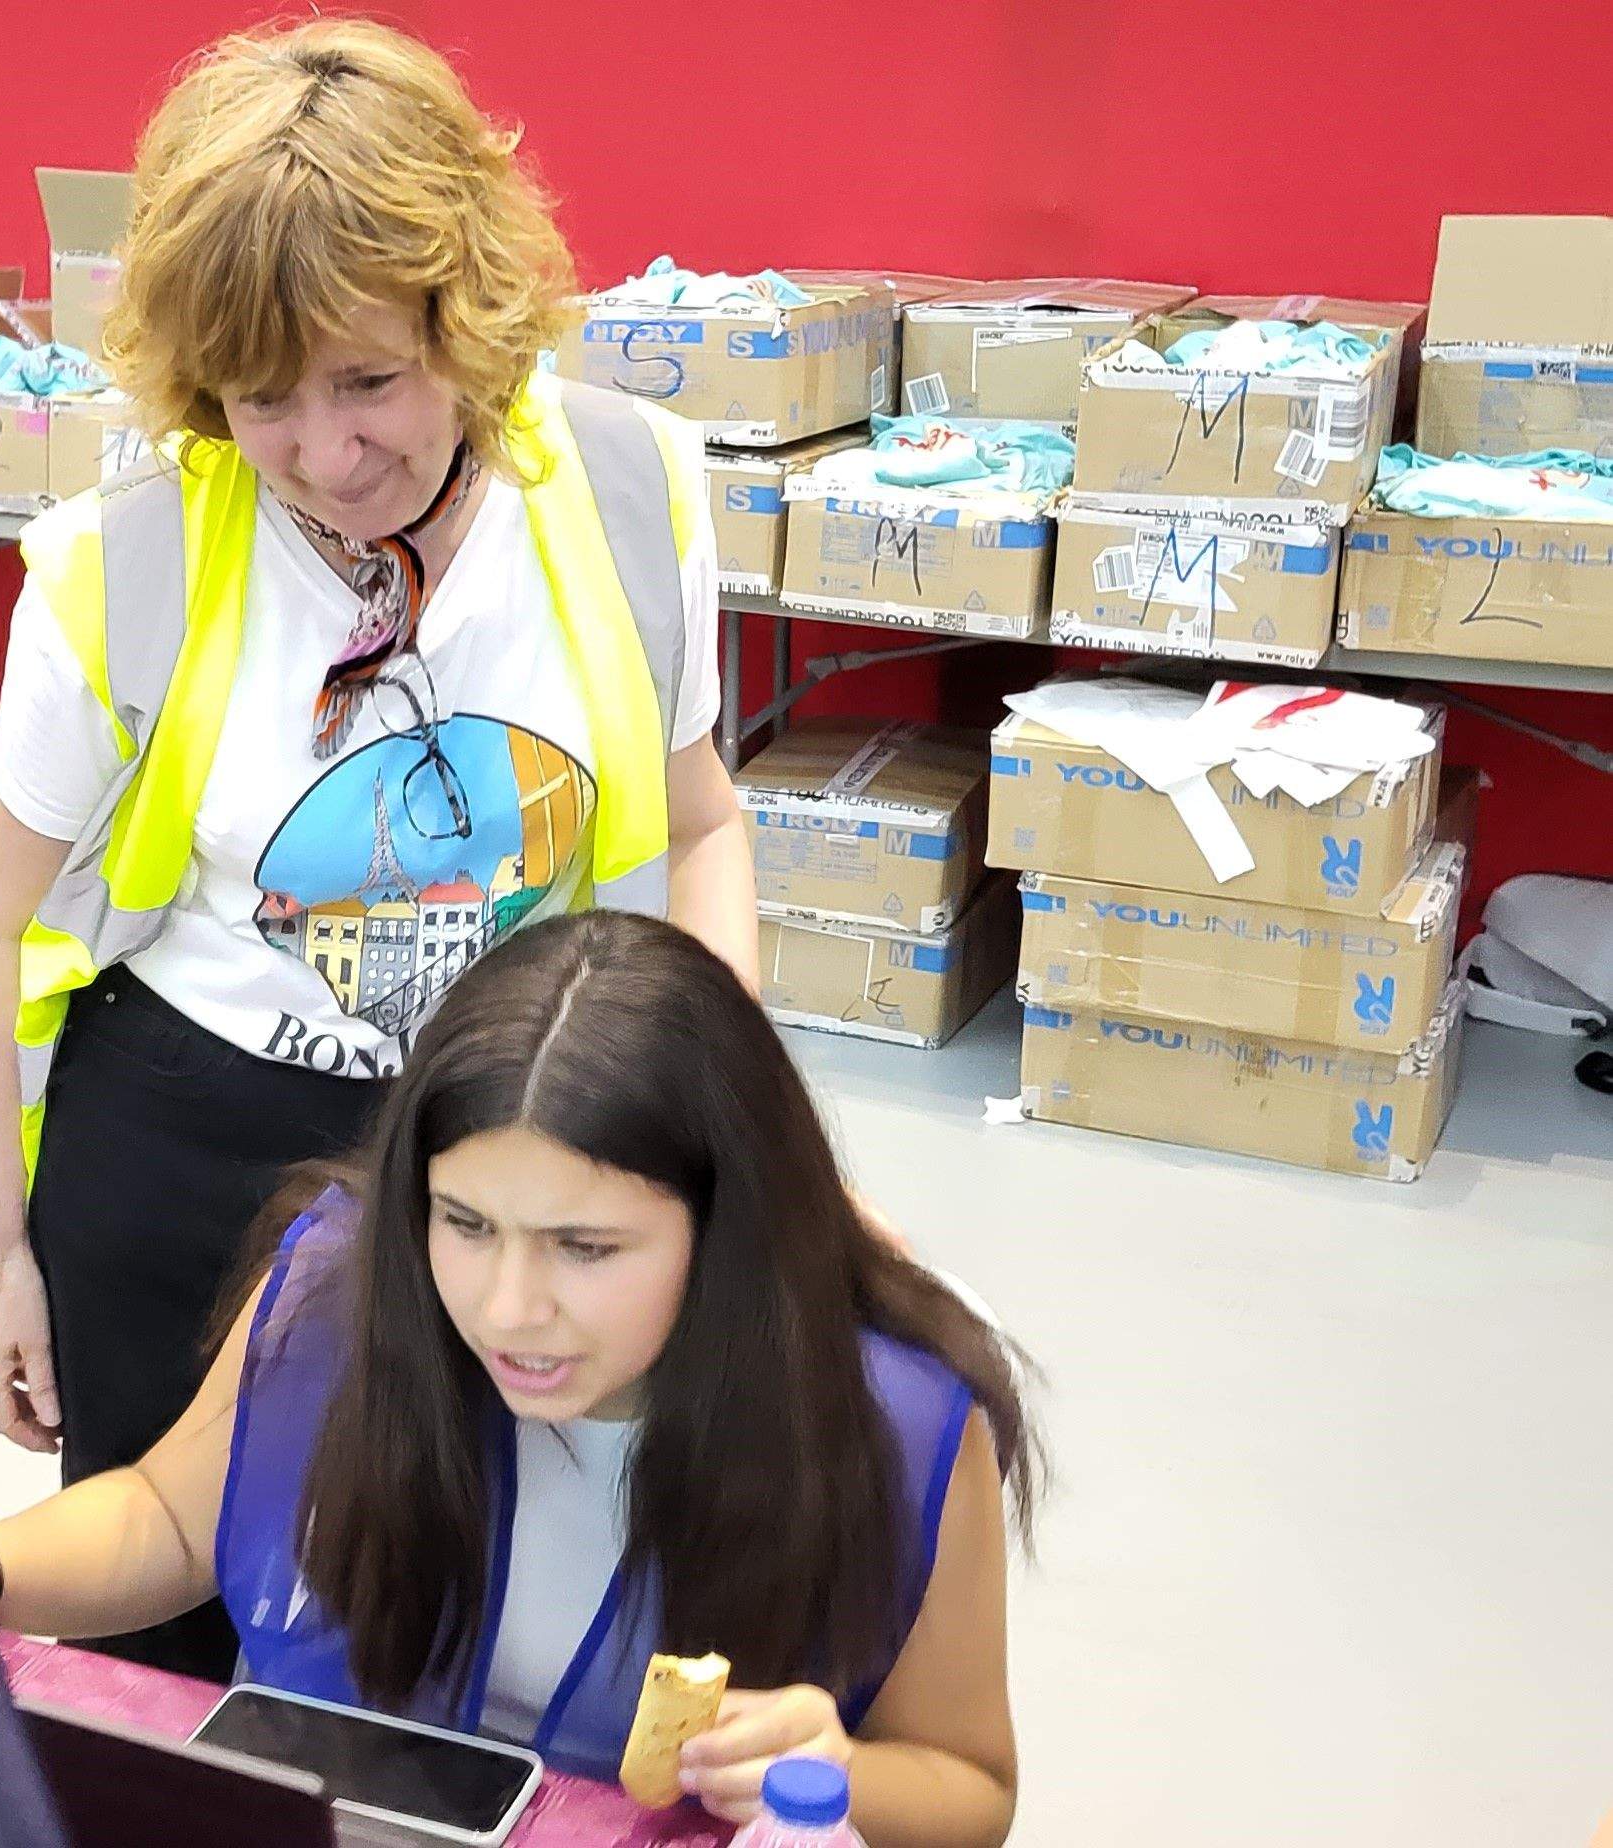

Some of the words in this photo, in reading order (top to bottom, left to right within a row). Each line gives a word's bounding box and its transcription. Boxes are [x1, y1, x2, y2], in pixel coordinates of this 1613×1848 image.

[729, 331, 755, 356] S
[612, 321, 684, 399] S
[1165, 372, 1248, 485] M
[727, 487, 752, 512] S
[973, 520, 999, 548] M
[1139, 526, 1219, 650] M
[888, 831, 912, 855] M
[890, 943, 914, 969] M
